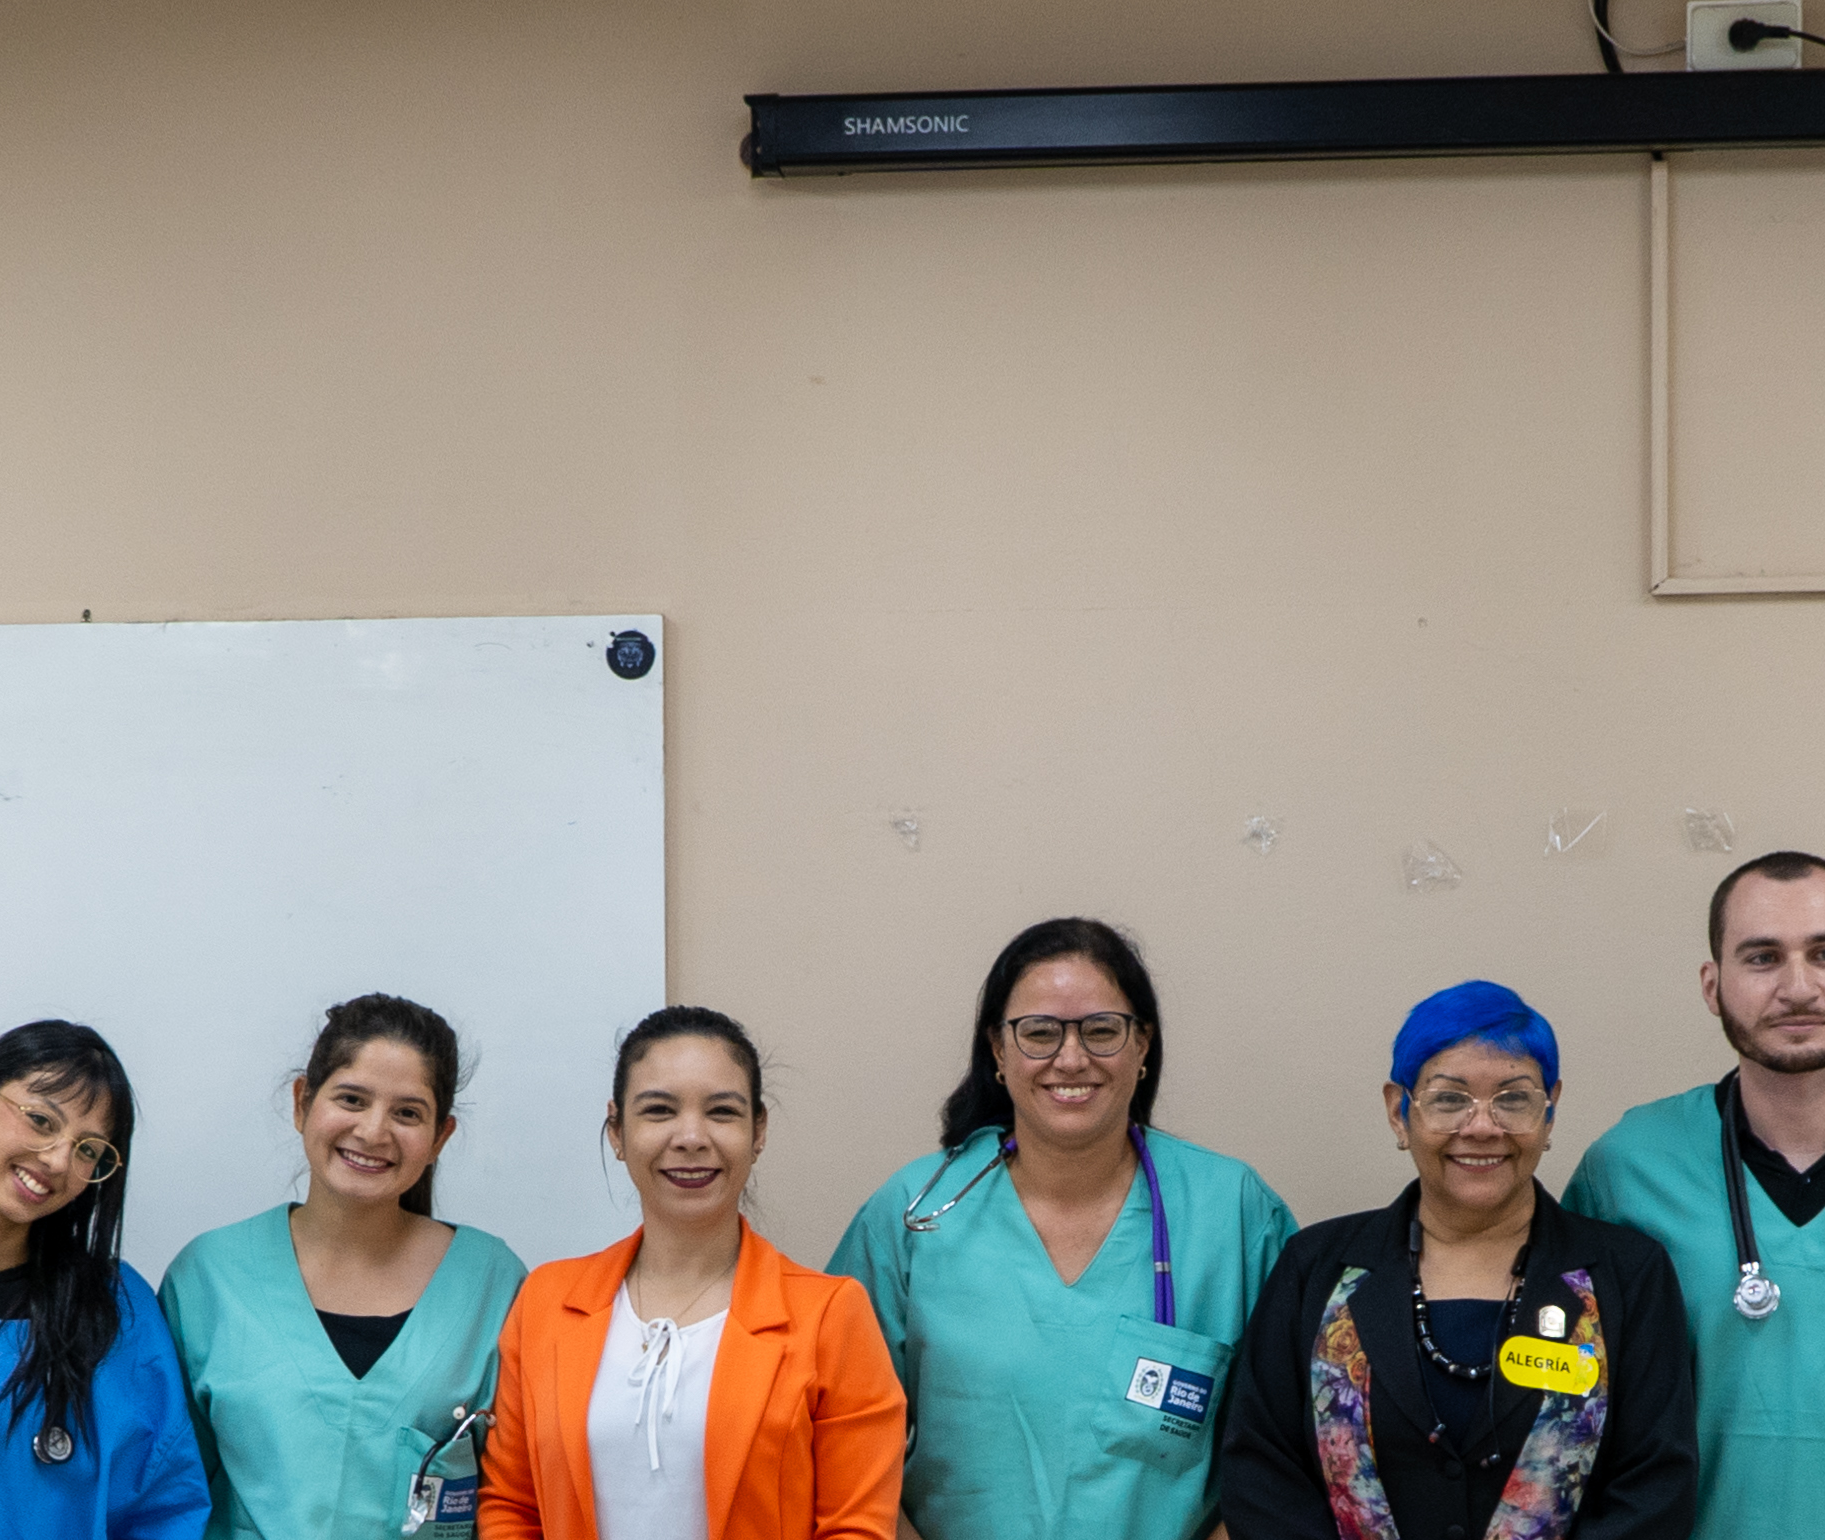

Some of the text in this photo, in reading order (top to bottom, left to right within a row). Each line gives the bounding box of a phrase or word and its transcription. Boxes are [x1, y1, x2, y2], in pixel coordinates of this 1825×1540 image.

[844, 115, 970, 135] SHAMSONIC
[1505, 1351, 1571, 1374] ALEGRÍA
[1170, 1386, 1201, 1402] Rio de
[1167, 1395, 1204, 1413] Janeiro
[442, 1495, 457, 1505] Rio
[440, 1504, 473, 1514] Janeiro
